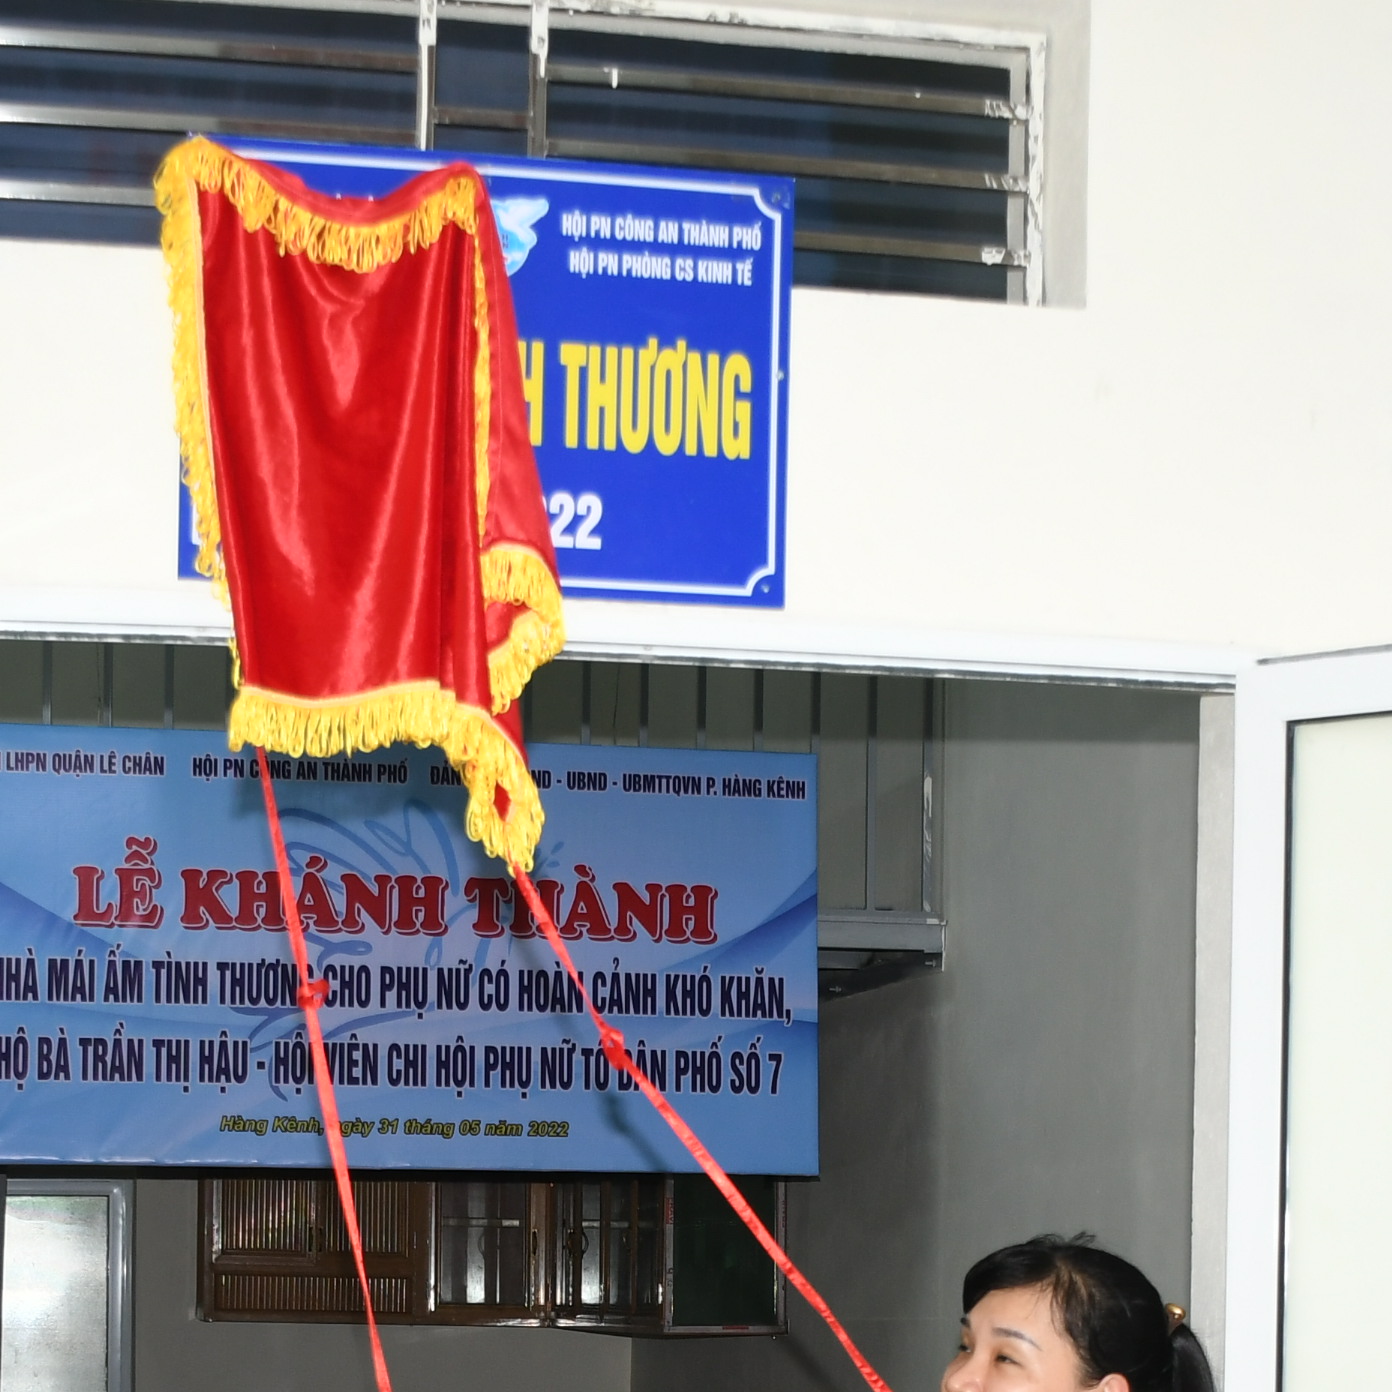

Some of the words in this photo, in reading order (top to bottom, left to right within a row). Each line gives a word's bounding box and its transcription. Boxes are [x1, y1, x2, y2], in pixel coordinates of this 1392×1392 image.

[562, 210, 586, 242] HỘI
[590, 216, 611, 239] PN
[615, 213, 654, 242] CÔNG
[658, 220, 679, 244] AN
[682, 219, 729, 248] THÀNH
[733, 222, 762, 251] PHỐ
[569, 247, 594, 279] HỘI
[598, 253, 618, 276] PN
[622, 251, 671, 280] PHÒNG
[675, 258, 694, 282] CS
[697, 259, 732, 285] KINH
[736, 257, 753, 286] TẾ
[560, 337, 752, 460] THƯƠNG
[542, 491, 603, 550] 22
[6, 751, 47, 772] LHPN
[52, 749, 95, 777] QUẬN
[99, 750, 117, 774] LÊ
[122, 752, 165, 776] CHÂN
[192, 753, 218, 781] HỘI
[223, 758, 244, 779] PN
[296, 761, 317, 780] AN
[322, 758, 372, 783] THÀNH
[377, 758, 407, 784] PHỐ
[430, 760, 462, 785] ĐẢN
[567, 771, 608, 791] UBND
[622, 773, 702, 797] UBMTTQVN
[706, 777, 717, 796] P.
[722, 774, 762, 798] HÀNG
[767, 776, 806, 800] KÊNH
[72, 836, 164, 930] LỄ
[180, 854, 450, 937] KHÁNH
[464, 863, 719, 945] THÀNH
[46, 949, 96, 1002] MÁI
[103, 943, 144, 1004] ẤM
[151, 951, 209, 1005] TÌNH
[323, 964, 371, 1008] CHO
[380, 965, 428, 1020] PHỤ
[436, 959, 473, 1011] NỮ
[478, 960, 509, 1012] CÓ
[518, 961, 584, 1013] HOÀN
[592, 957, 657, 1015] CẢNH
[665, 965, 712, 1017] KHÓ
[720, 967, 792, 1026] KHĂN,
[37, 1027, 71, 1081] BÀ
[79, 1022, 145, 1083] TRẦN
[152, 1038, 191, 1093] THỊ
[198, 1030, 248, 1094] HẬU
[323, 1033, 379, 1087] VIÊN
[387, 1042, 427, 1087] CHI
[435, 1035, 475, 1098] HỘI
[484, 1045, 532, 1099] PHỤ
[540, 1038, 576, 1090] NỮ
[675, 1035, 722, 1093] PHỐ
[730, 1036, 763, 1095] SỐ
[768, 1053, 782, 1095] 7
[219, 1115, 268, 1136] Hàng
[272, 1115, 324, 1137] Kênh,
[340, 1117, 375, 1138] gày
[378, 1118, 398, 1134] 31
[404, 1117, 455, 1139] tháng
[459, 1120, 480, 1136] 05
[484, 1119, 523, 1136] năm
[527, 1120, 570, 1138] 2022
